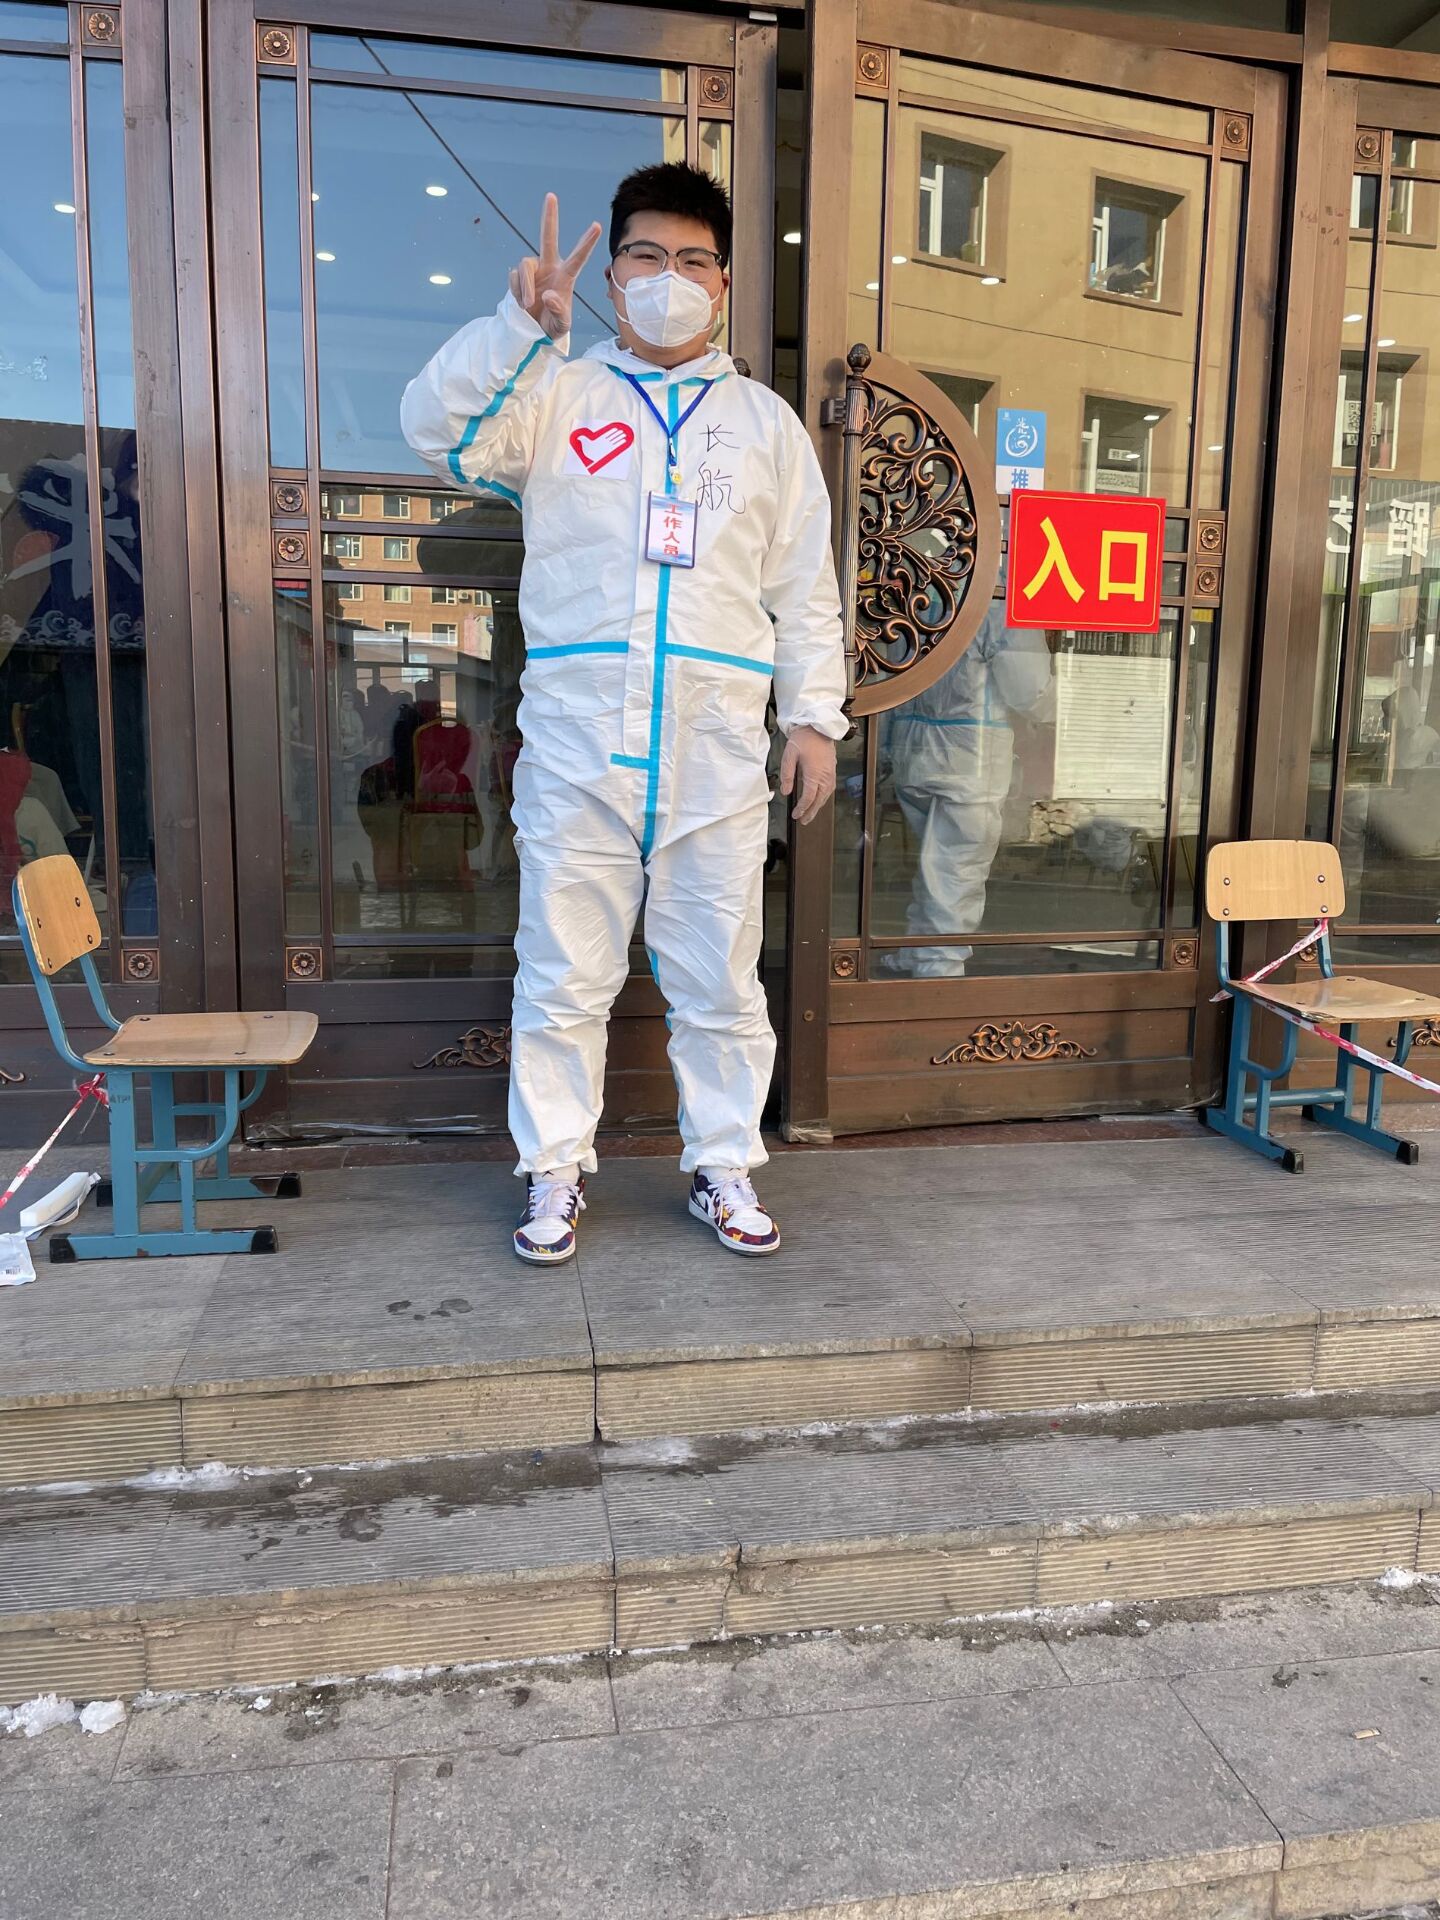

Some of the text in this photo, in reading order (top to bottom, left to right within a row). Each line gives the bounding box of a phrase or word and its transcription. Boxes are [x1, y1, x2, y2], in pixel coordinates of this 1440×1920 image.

[697, 423, 746, 515] 长航
[1011, 468, 1030, 488] 推
[663, 503, 683, 558] 工作人员
[1023, 516, 1147, 603] 入口
